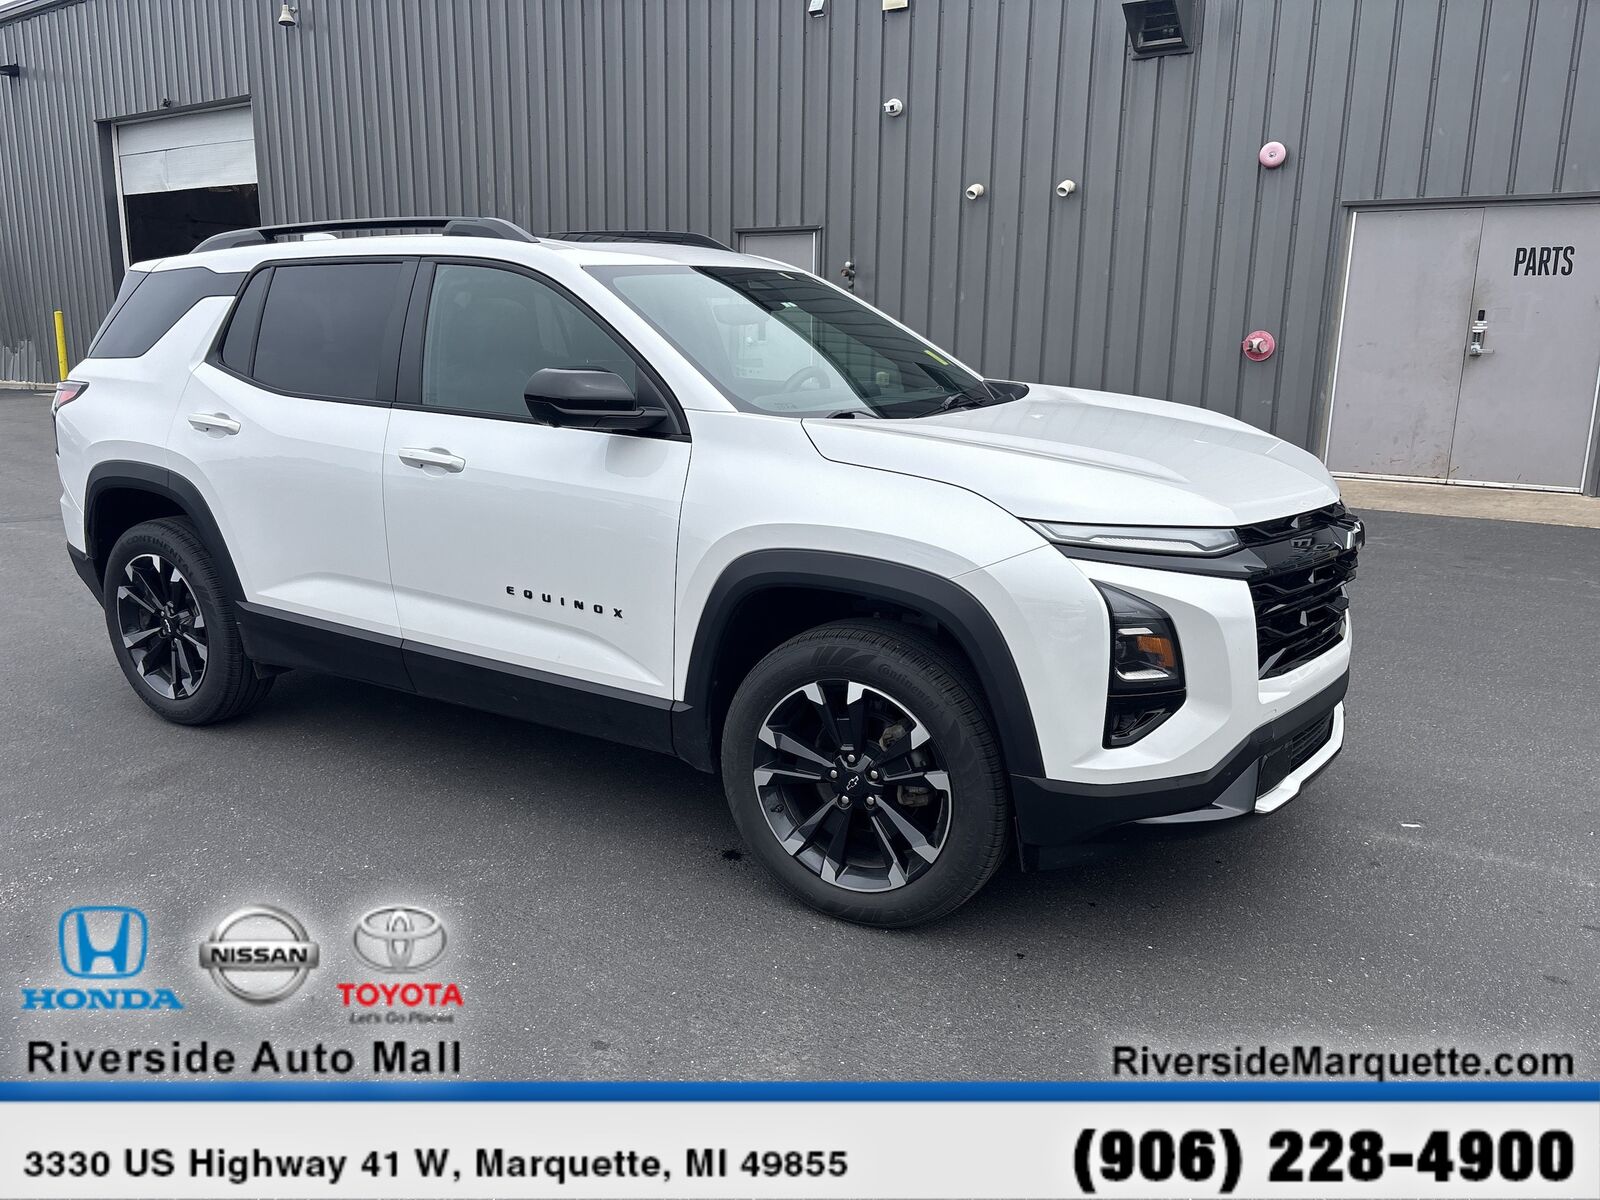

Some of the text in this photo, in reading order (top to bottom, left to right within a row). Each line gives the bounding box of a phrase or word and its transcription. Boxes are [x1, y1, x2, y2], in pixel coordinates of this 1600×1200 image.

[1513, 245, 1575, 277] PARTS
[506, 585, 624, 619] EQUINOX
[878, 663, 941, 711] Continental
